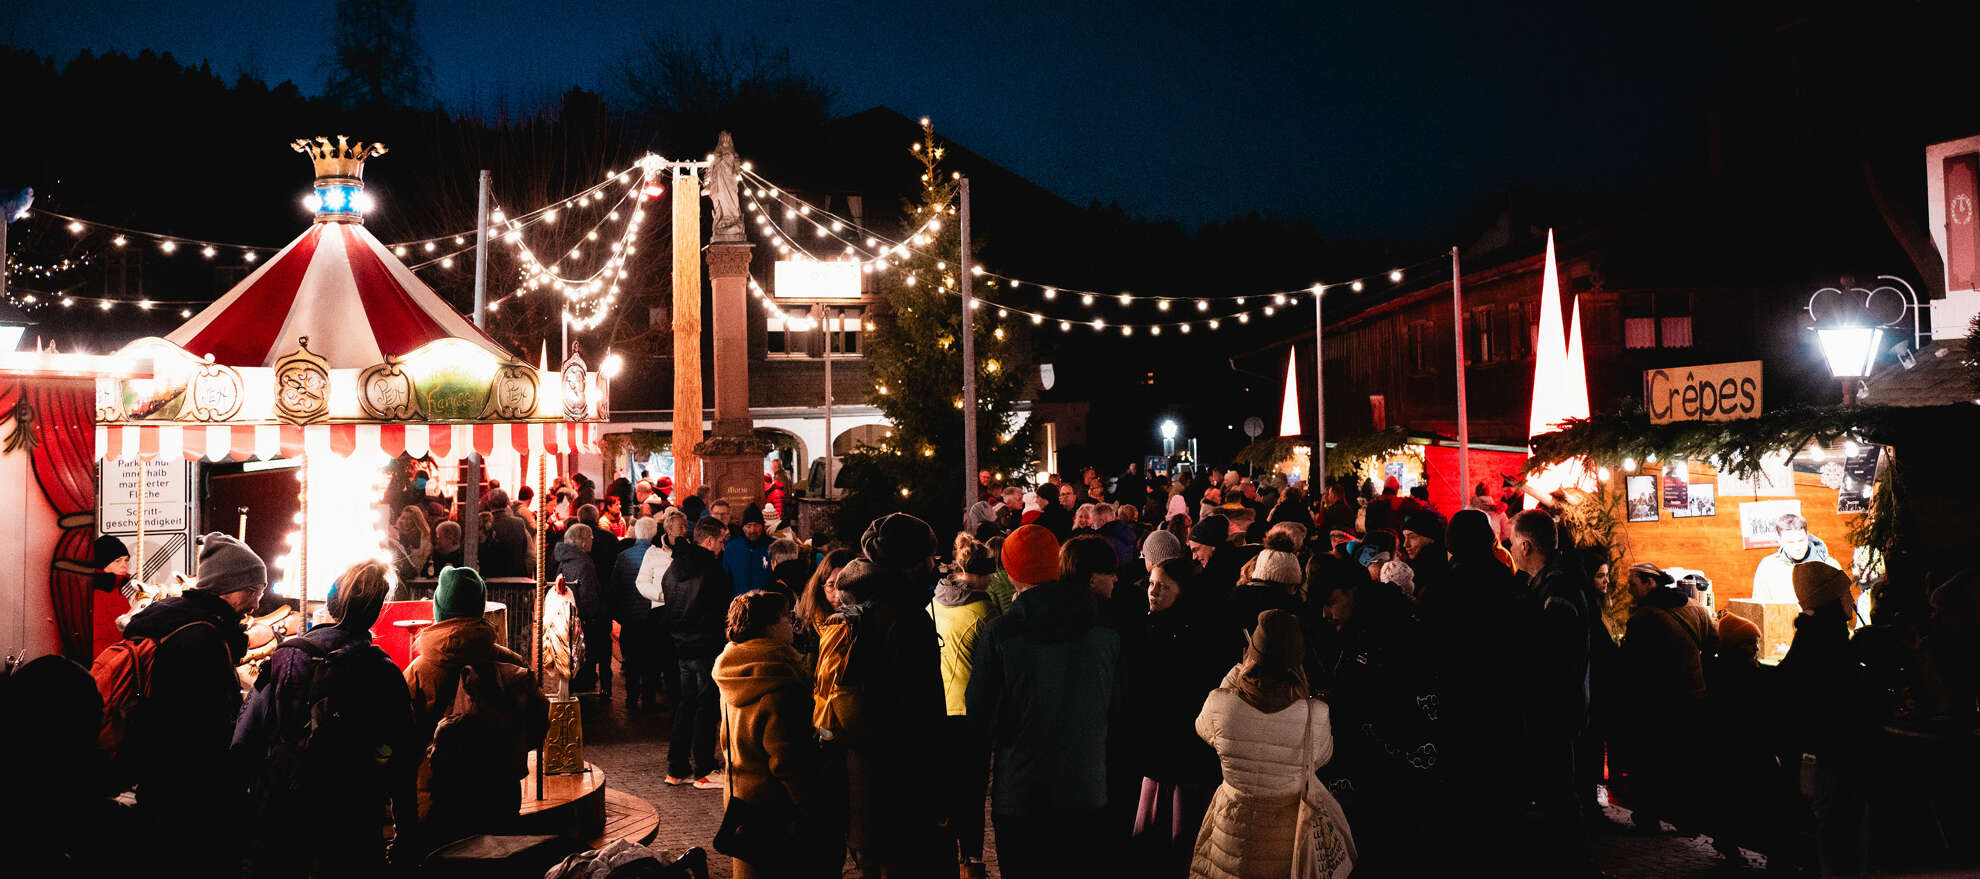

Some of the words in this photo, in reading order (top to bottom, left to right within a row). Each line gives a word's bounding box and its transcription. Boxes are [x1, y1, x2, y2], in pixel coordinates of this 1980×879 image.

[1649, 370, 1757, 422] Crêpes
[118, 459, 151, 468] Parkn
[122, 469, 167, 478] innehalb
[119, 480, 169, 489] marerter
[129, 490, 160, 499] Flche
[126, 508, 162, 516] Scritt-
[105, 517, 182, 529] geschwndigkeit
